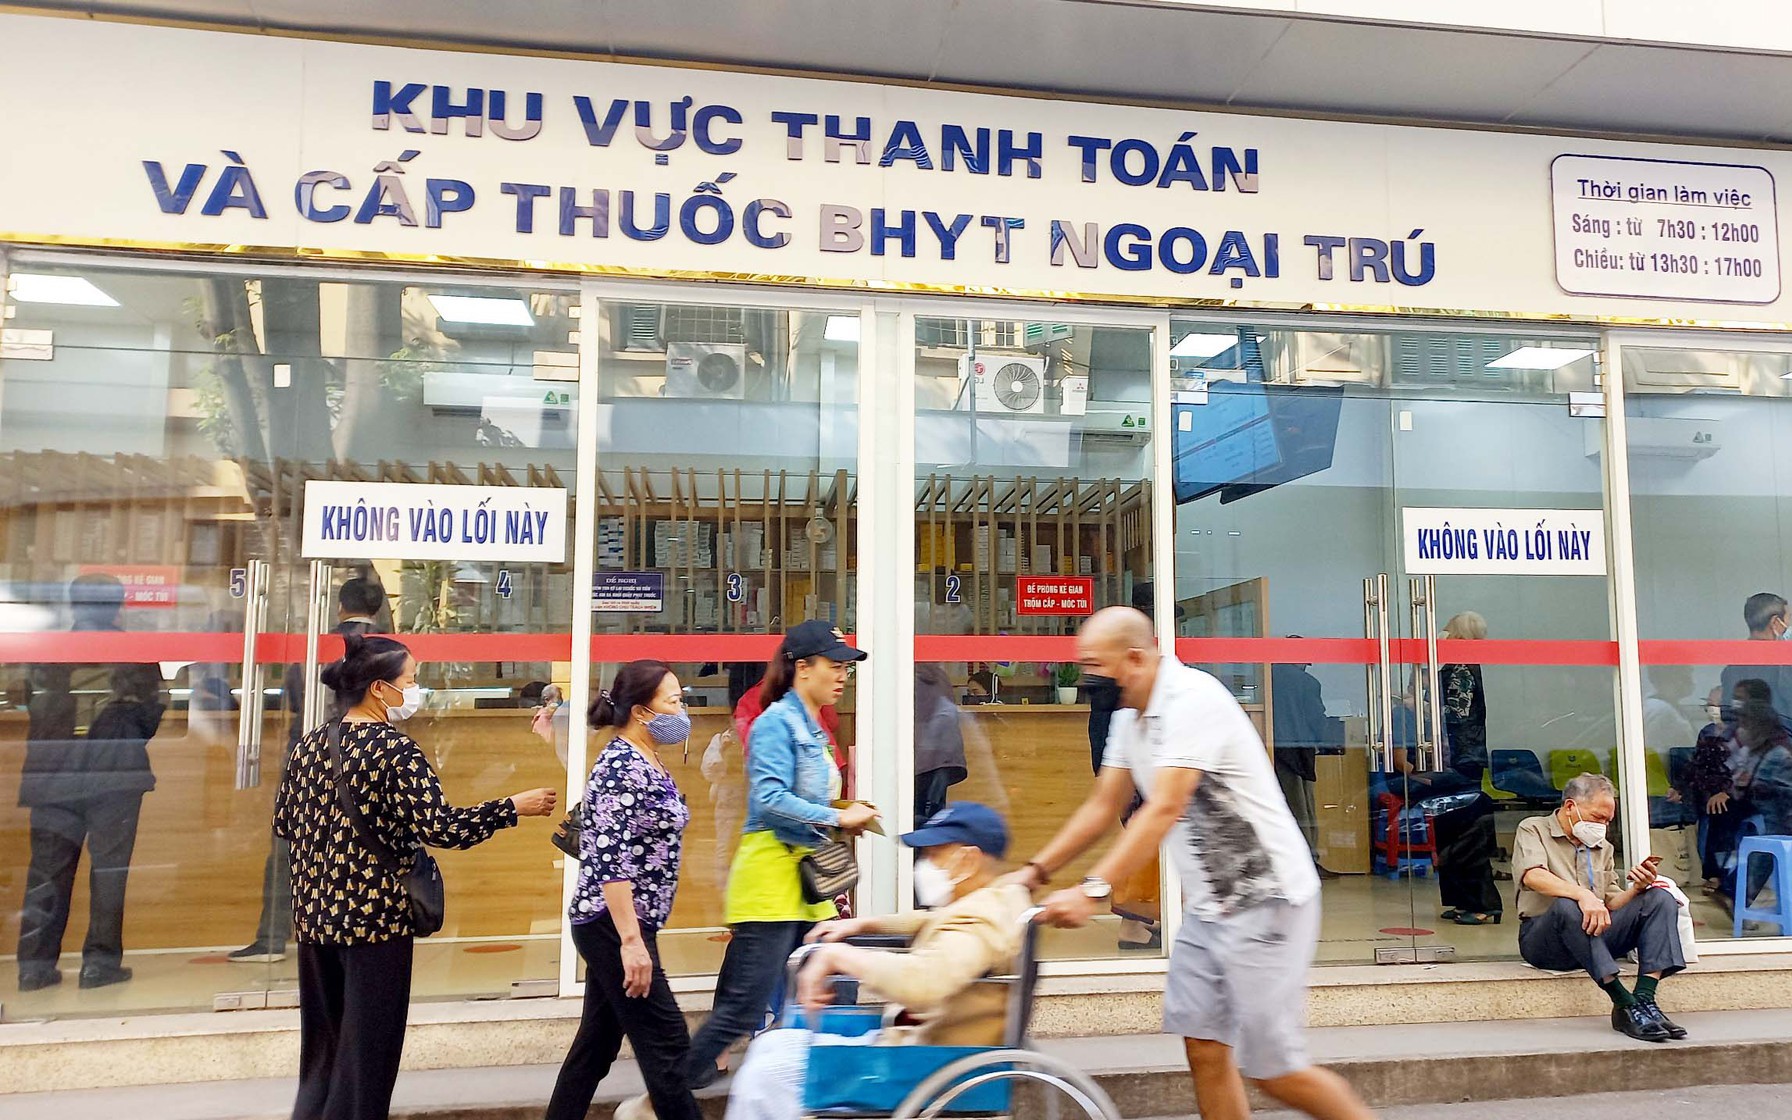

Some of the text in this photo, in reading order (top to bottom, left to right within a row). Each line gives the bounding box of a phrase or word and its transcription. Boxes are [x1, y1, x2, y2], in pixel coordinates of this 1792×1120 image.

[372, 80, 1259, 194] KHU VỰC THANH TOÁN
[1577, 179, 1751, 210] Thời gian làm việc
[142, 150, 1435, 289] VÀ CẤP THUỐC BHYT NGOẠI TRÚ
[1572, 213, 1611, 238] Sáng
[1626, 217, 1643, 237] từ
[1657, 219, 1696, 240] 7h30
[1711, 222, 1760, 243] 12h00
[1629, 252, 1645, 272] từ
[1650, 253, 1698, 274] 13h30
[1714, 257, 1762, 277] 17h00
[321, 497, 549, 545] KHÔNG VÀO LỐI NÀY
[1417, 519, 1591, 560] KHÔNG VÀO LỐI NÀY
[229, 568, 247, 599] 5
[495, 569, 513, 599] 4
[726, 572, 742, 602] 3
[945, 575, 961, 603] 2
[1068, 585, 1084, 594] GIAN
